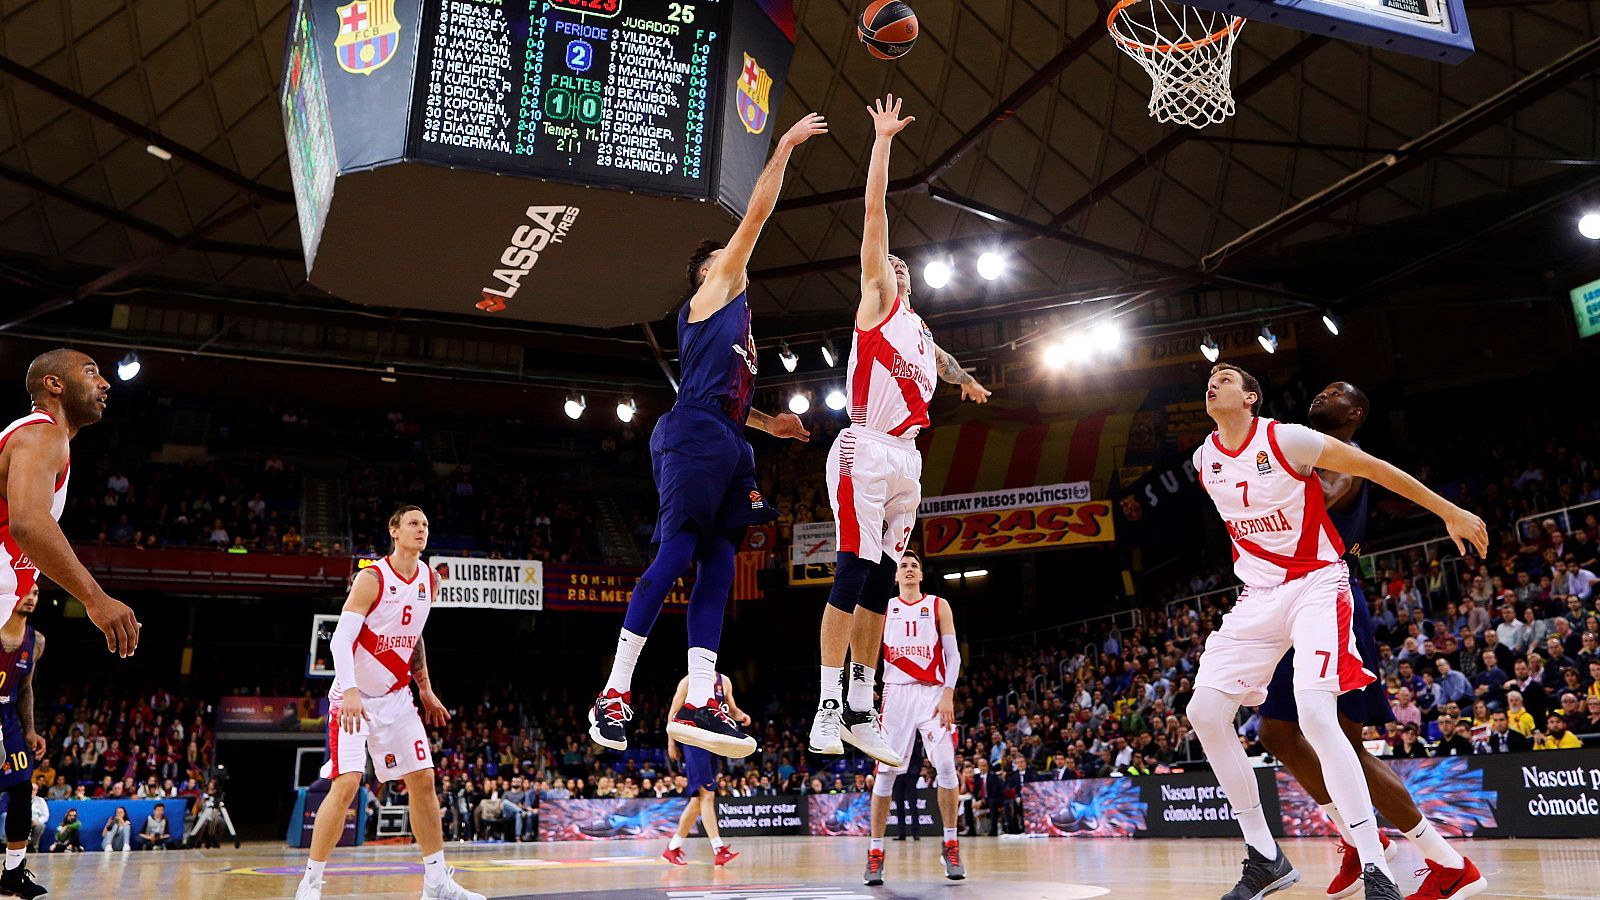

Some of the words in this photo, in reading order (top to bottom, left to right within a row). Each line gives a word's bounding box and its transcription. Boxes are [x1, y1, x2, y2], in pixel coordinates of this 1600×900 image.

[450, 2, 492, 19] RIBAS,
[530, 15, 547, 27] 1-0
[529, 0, 537, 10] F
[542, 2, 550, 13] P
[668, 3, 695, 24] 25
[451, 14, 510, 34] PRESSEY,
[555, 21, 608, 40] PERIODE
[622, 17, 680, 35] JUGADOR
[696, 29, 704, 39] F
[709, 32, 716, 41] P
[435, 35, 447, 47] 10
[450, 38, 510, 58] JACKSON,
[526, 50, 544, 62] 0-2
[450, 25, 496, 44] HANGA,
[526, 38, 545, 50] 0-0
[612, 29, 620, 39] 3
[693, 43, 710, 55] 1-0
[433, 47, 442, 58] 11
[524, 61, 542, 74] 0-0
[572, 46, 585, 65] 2
[620, 42, 665, 59] TIMMA,
[432, 58, 444, 70] 13
[446, 60, 504, 81] HEURTEL,
[523, 72, 541, 86] 1-2
[610, 52, 616, 62] 7
[618, 53, 690, 75] VOIGTMANN
[430, 71, 441, 82] 17
[444, 72, 499, 92] KURUCS,
[502, 81, 512, 93] R
[522, 84, 540, 97] 0-0
[551, 74, 601, 92] FALTES
[618, 65, 685, 86] MALMANIS,
[690, 76, 707, 88] 0-0
[618, 76, 674, 96] HUERTAS,
[689, 87, 706, 99] 0-0
[427, 94, 441, 106] 25
[444, 96, 507, 118] KOPONEN,
[519, 108, 542, 121] 0-10
[444, 84, 493, 103] ORIOLA,
[496, 92, 505, 103] P
[520, 96, 539, 108] 0-2
[552, 94, 564, 114] 1
[583, 99, 596, 118] 0
[603, 97, 612, 108] 11
[614, 99, 668, 118] JANNING,
[604, 86, 615, 97] 10
[618, 88, 680, 108] BEAUBOIS,
[426, 106, 441, 118] 30
[444, 108, 498, 128] CLAVER,
[518, 120, 536, 132] 2-0
[602, 109, 613, 119] 12
[686, 121, 703, 133] 0-2
[423, 130, 437, 142] 45
[440, 132, 512, 154] MOERMAN,
[516, 143, 534, 155] 2-0
[424, 118, 440, 130] 32
[443, 120, 494, 140] DIAGNE,
[497, 129, 506, 140] A
[517, 132, 535, 144] 1-0
[543, 122, 578, 140] Temps
[601, 121, 611, 130] 15
[613, 122, 674, 142] GRANGER,
[685, 132, 702, 143] 1-0
[598, 143, 613, 154] 23
[616, 146, 678, 164] SHENGELIA
[683, 156, 700, 167] 0-2
[600, 132, 610, 142] 17
[612, 133, 661, 152] POIRIER,
[684, 144, 701, 155] 1-2
[614, 157, 663, 175] GARINO,
[666, 164, 674, 174] P
[682, 166, 700, 179] 1-2
[550, 206, 580, 243] TYRES
[482, 206, 566, 298] LASSA
[919, 498, 972, 514] LLIBERTAT
[974, 494, 1016, 509] PRESOS
[1019, 488, 1072, 504] POLÍTICS!
[1235, 480, 1250, 508] 7
[925, 504, 1109, 553] DRACS
[455, 564, 520, 582] LLIBERTAT
[483, 585, 540, 605] POLÍTICS!
[401, 605, 412, 626] 6
[905, 621, 917, 637] 11
[1315, 650, 1331, 678] 7
[10, 751, 28, 771] 10
[415, 740, 426, 761] 6
[1522, 766, 1587, 788] Nascut
[1160, 784, 1196, 801] Nascut
[1197, 786, 1214, 803] per
[1528, 793, 1599, 816] còmode
[718, 804, 753, 815] Nascut
[755, 805, 771, 816] per
[772, 804, 797, 814] estar
[758, 818, 771, 827] en
[772, 815, 782, 826] el
[1204, 807, 1218, 821] en
[1218, 803, 1229, 820] el
